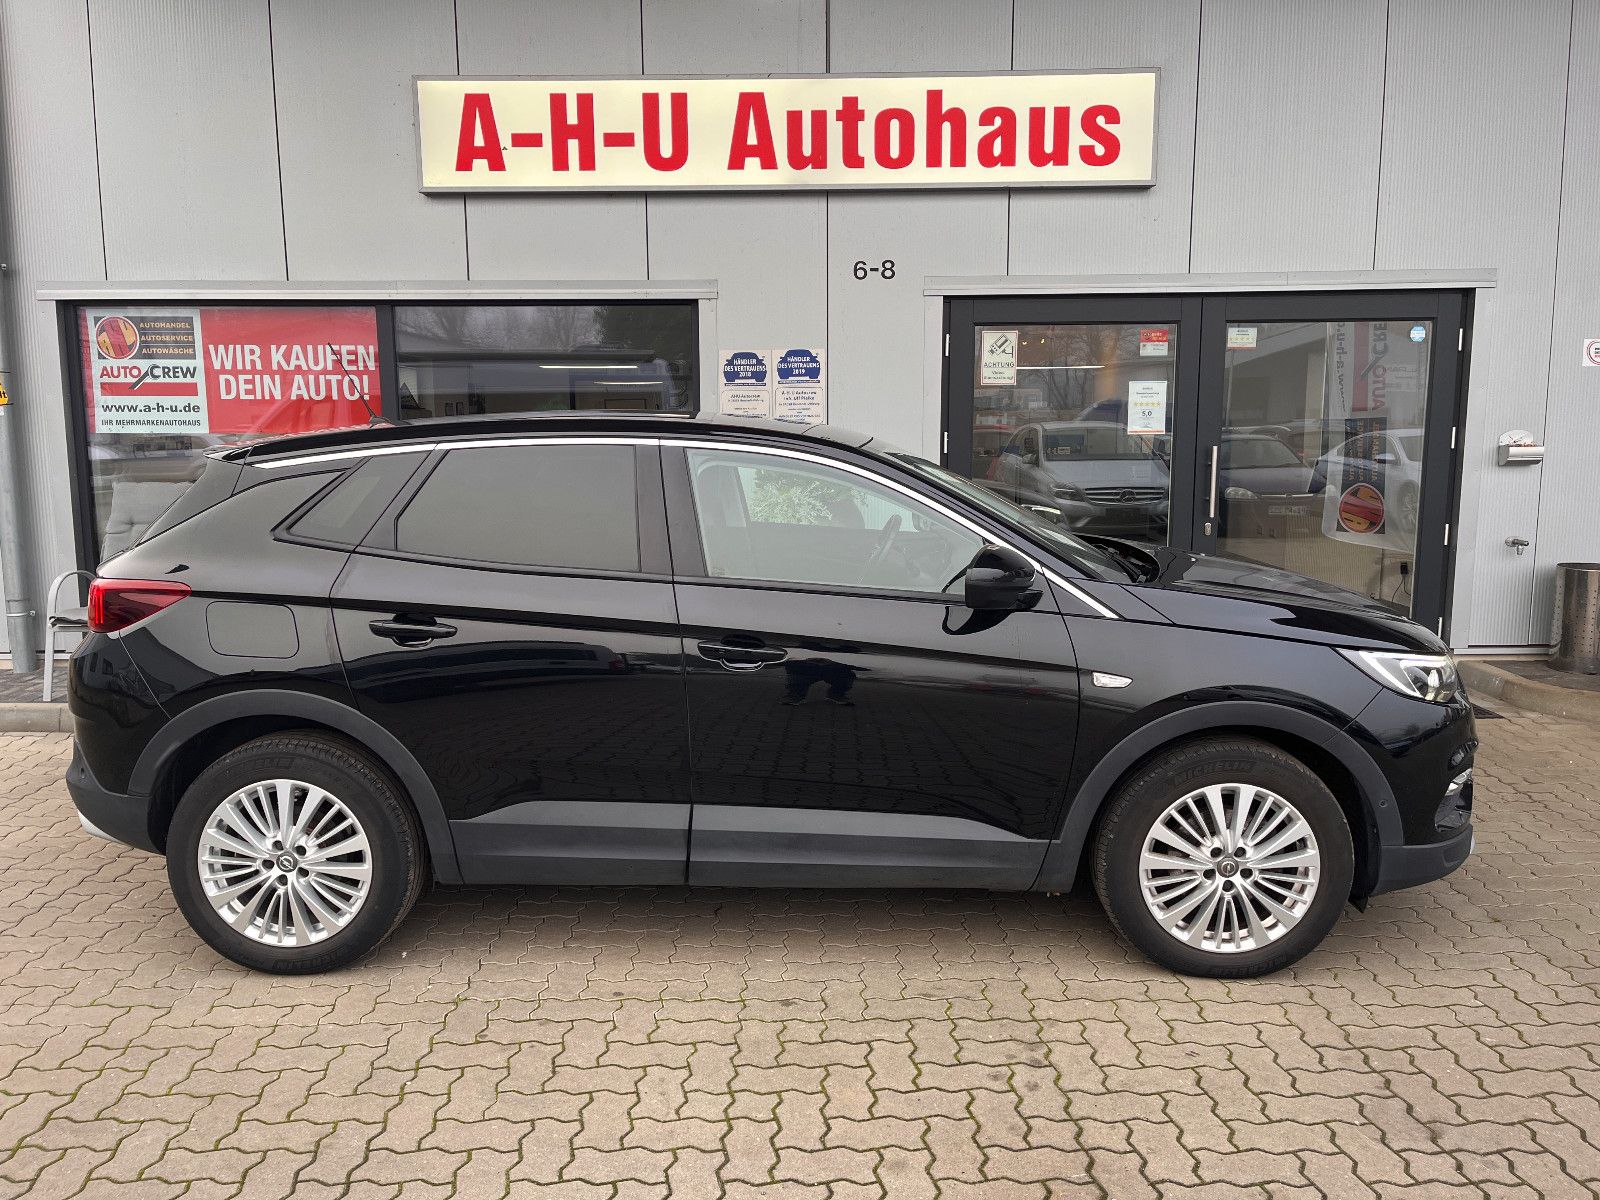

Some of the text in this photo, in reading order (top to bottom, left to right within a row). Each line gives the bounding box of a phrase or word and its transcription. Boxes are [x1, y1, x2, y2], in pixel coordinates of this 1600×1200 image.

[455, 88, 1122, 172] A-H-U Autohaus
[852, 259, 897, 281] 6-8
[139, 321, 191, 329] AUTOHANDEL
[140, 334, 194, 342] AUTOSERVICE
[141, 346, 194, 355] AUTOWÄSCHE
[208, 344, 376, 371] WIR KAUFEN
[99, 363, 197, 379] AUTO CREW
[219, 374, 370, 401] DEIN AUTO!
[101, 402, 201, 414] www.a-h-u.de
[101, 418, 201, 427] IHR MEHRMARKENAUTOHAUS
